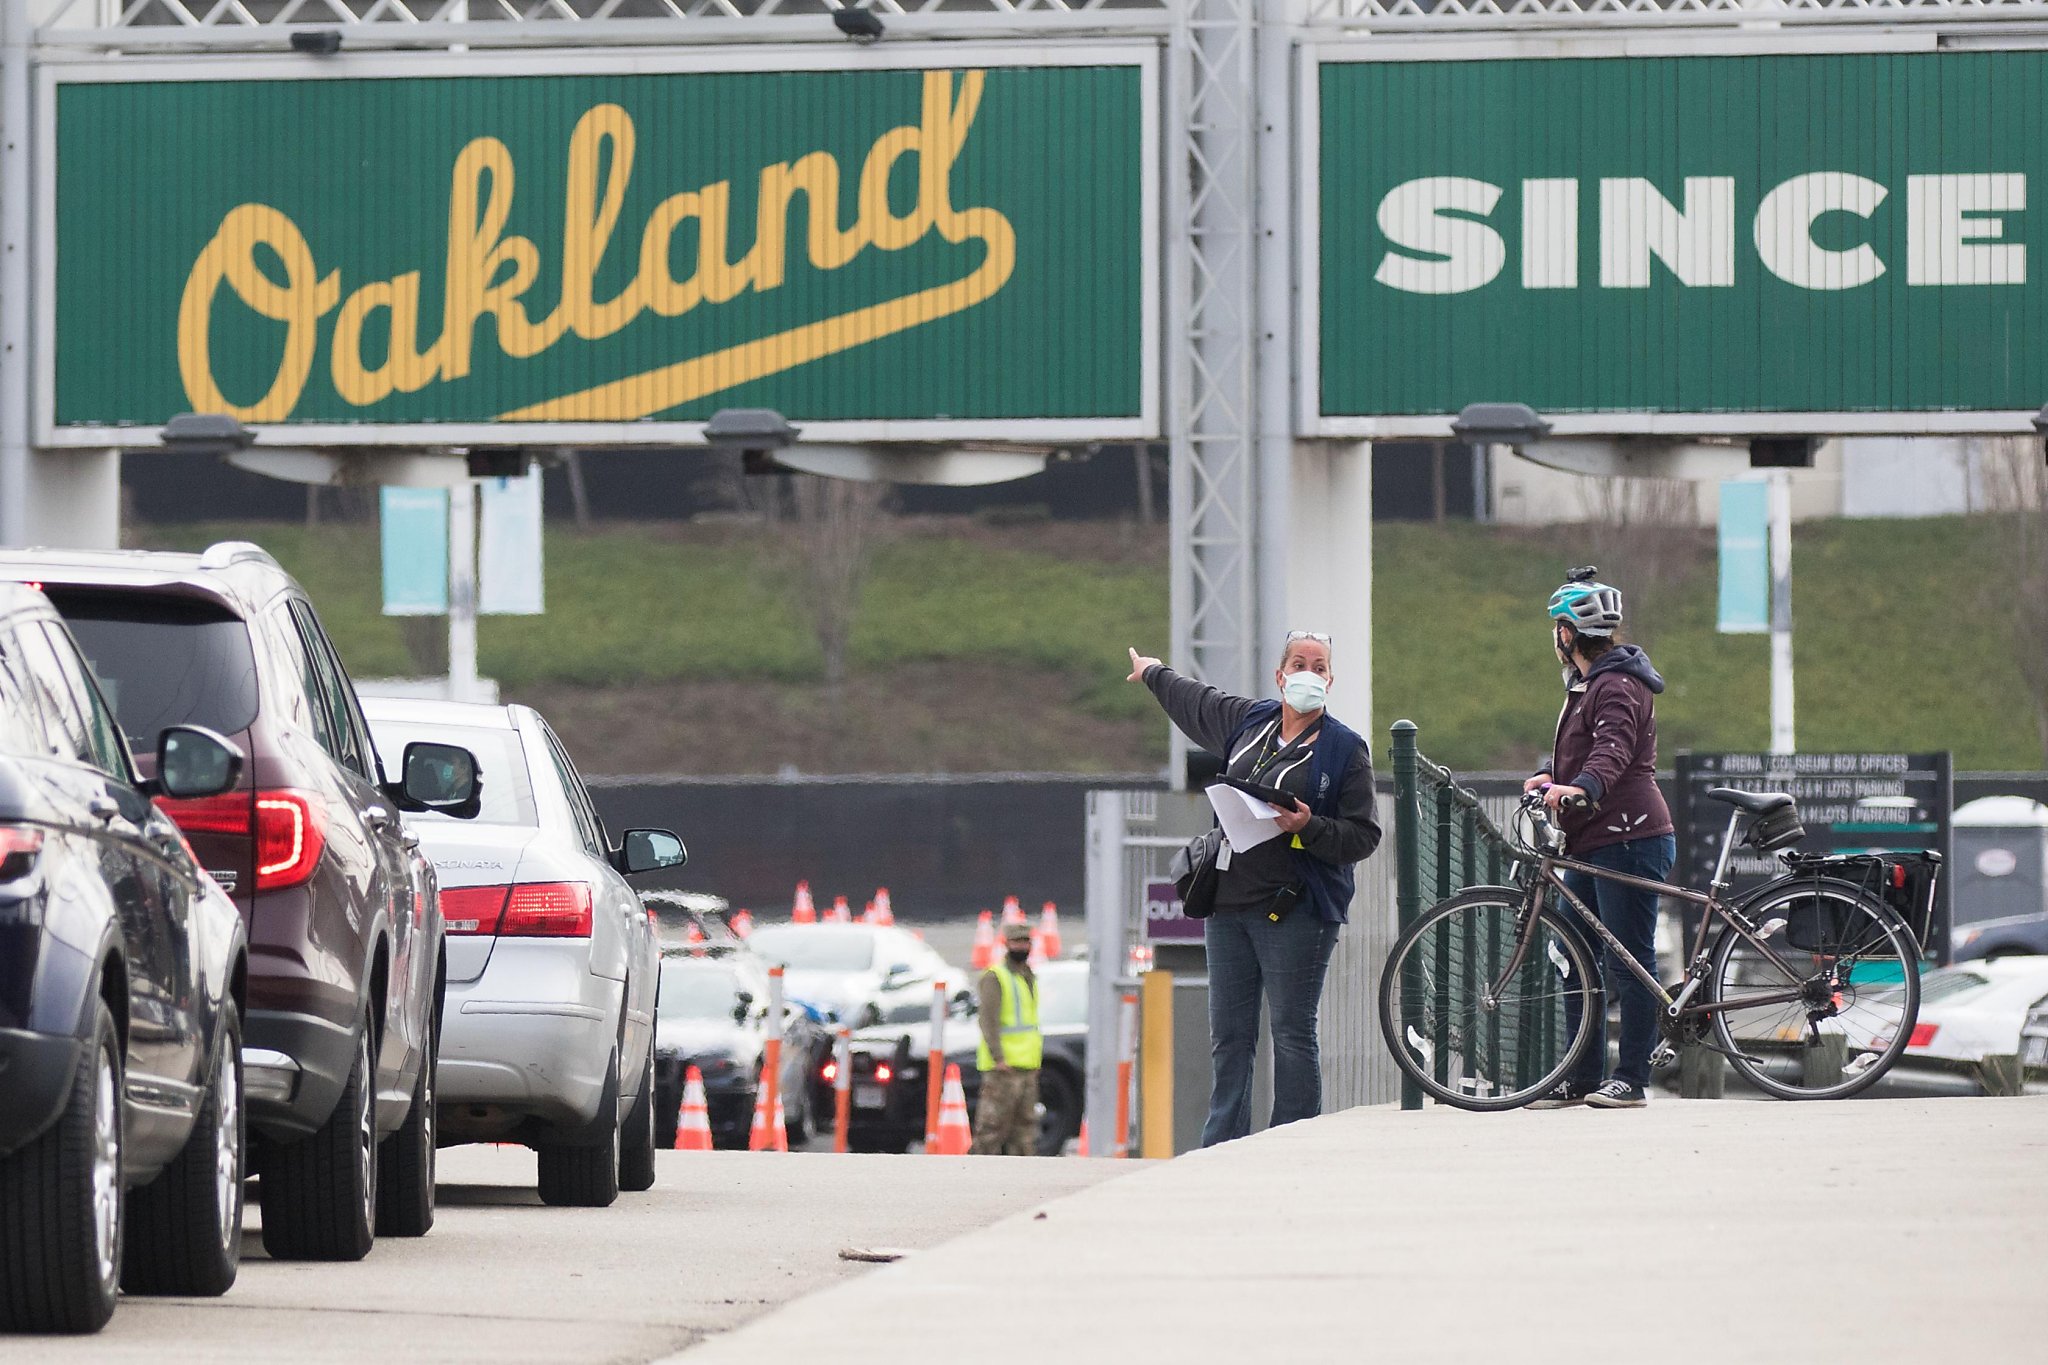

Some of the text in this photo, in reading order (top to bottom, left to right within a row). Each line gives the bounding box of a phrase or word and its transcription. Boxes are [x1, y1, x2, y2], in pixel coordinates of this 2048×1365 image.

[1374, 171, 2027, 295] SINCE
[177, 69, 1017, 423] Oakland
[1721, 754, 1763, 773] ARENA
[1833, 754, 1858, 773] BOX
[1860, 754, 1909, 773] OFFICES
[1827, 779, 1853, 798] LOTS
[1852, 805, 1910, 824] (PARKING)
[434, 859, 504, 870] SONATA
[1571, 899, 1635, 966] NOVARA
